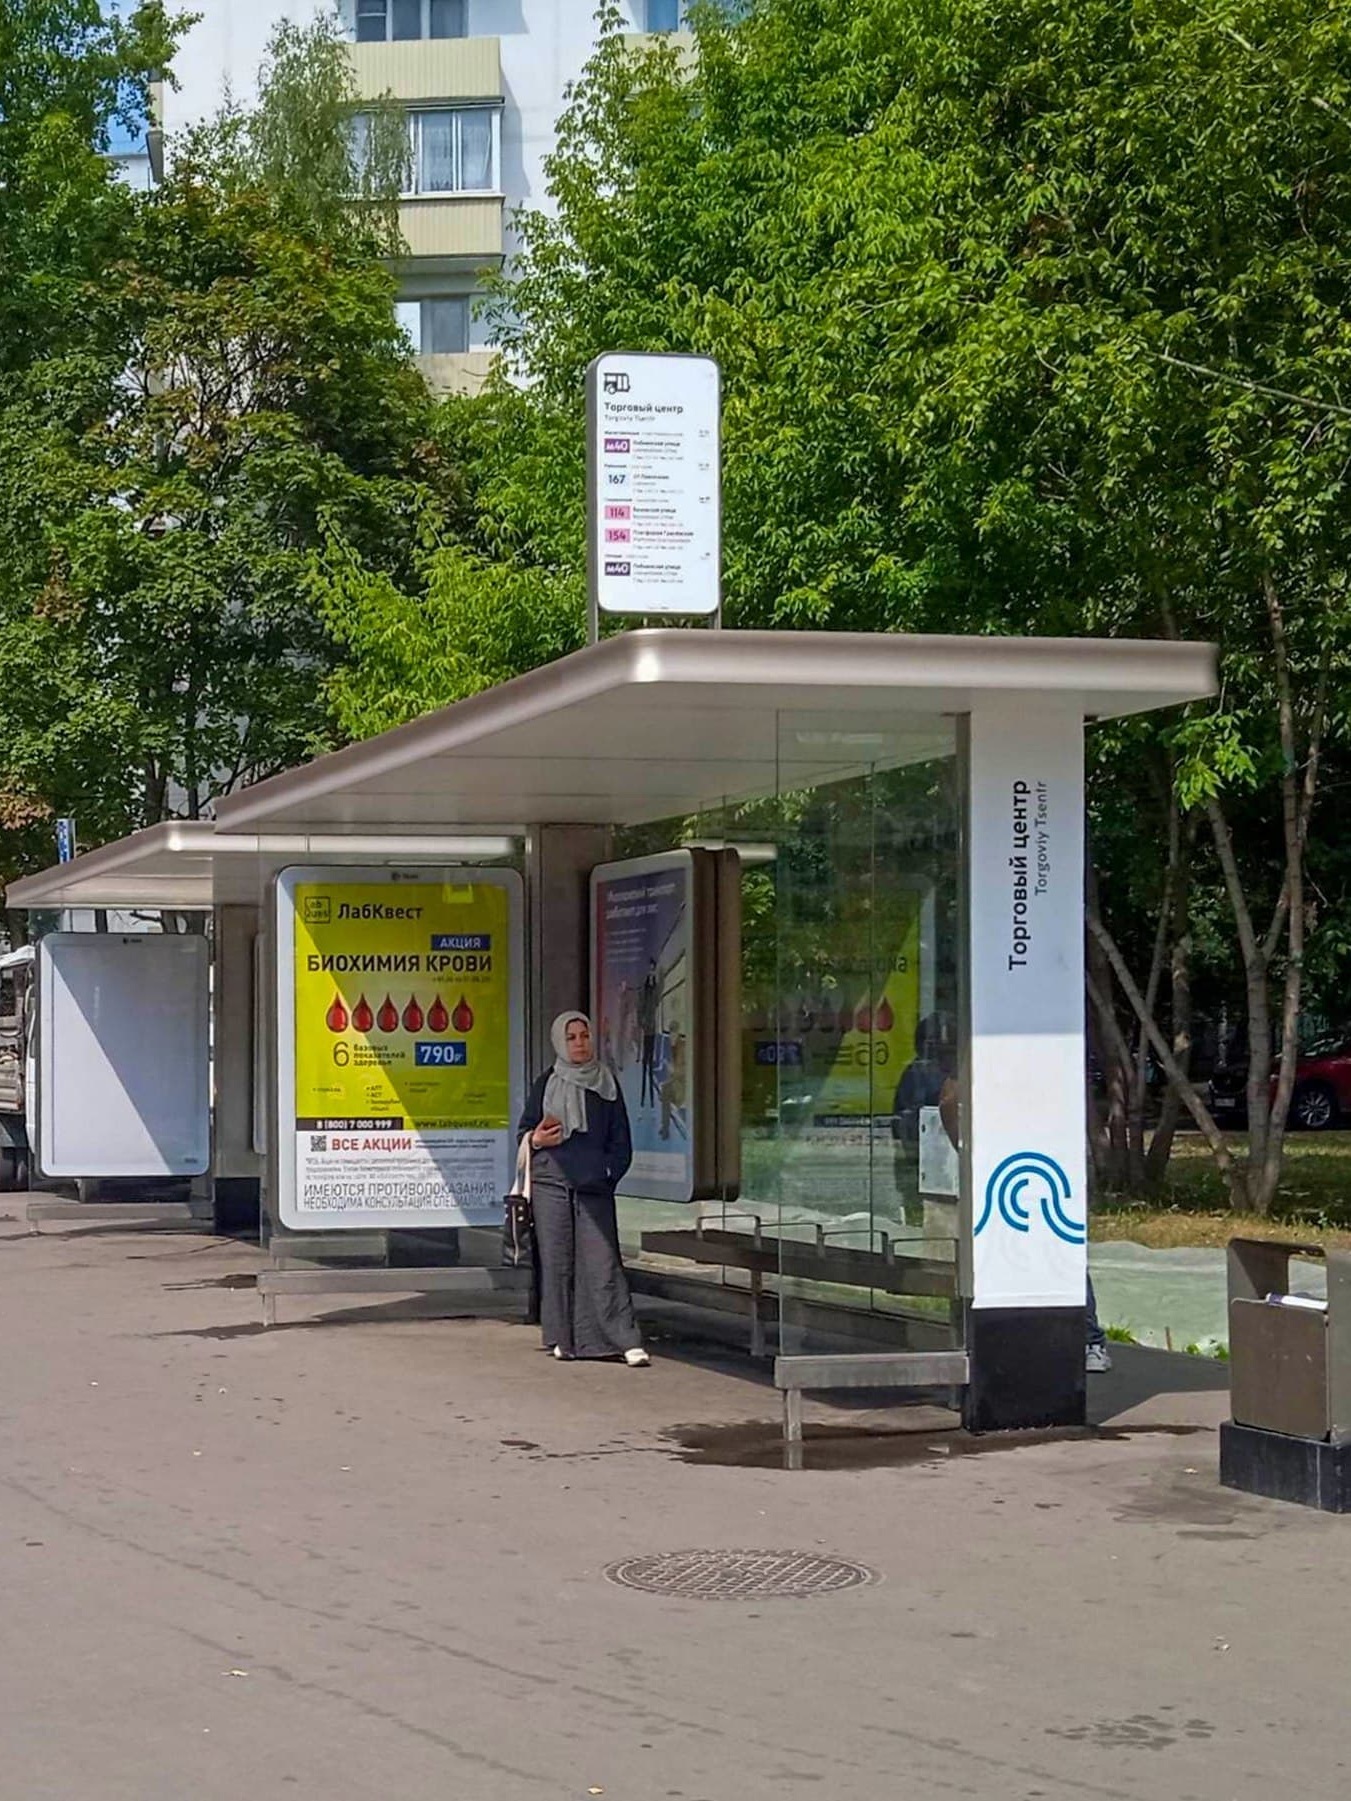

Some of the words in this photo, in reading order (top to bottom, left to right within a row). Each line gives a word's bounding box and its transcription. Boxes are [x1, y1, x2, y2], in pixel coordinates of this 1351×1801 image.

[604, 402, 652, 413] Торговый
[654, 404, 684, 414] центр
[608, 474, 626, 484] 167
[610, 508, 625, 518] 114
[609, 530, 626, 541] 154
[606, 564, 628, 574] м40
[1034, 781, 1048, 827] Tsentr
[1013, 780, 1031, 849] центр
[1034, 833, 1050, 896] Torgoviy
[338, 903, 424, 920] ЛабКвест
[1008, 856, 1031, 971] Торговый
[440, 937, 482, 949] АКЦИЯ
[307, 955, 419, 972] БИОХИМИЯ
[426, 955, 492, 972] КРОВИ
[333, 1041, 349, 1067] 6
[324, 1119, 347, 1129] (800)
[350, 1120, 355, 1129] 7
[356, 1120, 373, 1128] 000
[375, 1119, 392, 1128] 999
[332, 1138, 359, 1150] ВСЕ
[362, 1138, 412, 1152] АКЦИИ
[304, 1183, 364, 1196] ИМЕЮТСЯ
[368, 1182, 495, 1196] ПРОТИВОПОКАЗАНИЯ
[304, 1196, 362, 1209] НЕОБХОДИМА
[365, 1195, 430, 1209] КОНСУЛЬТАЦИЯ
